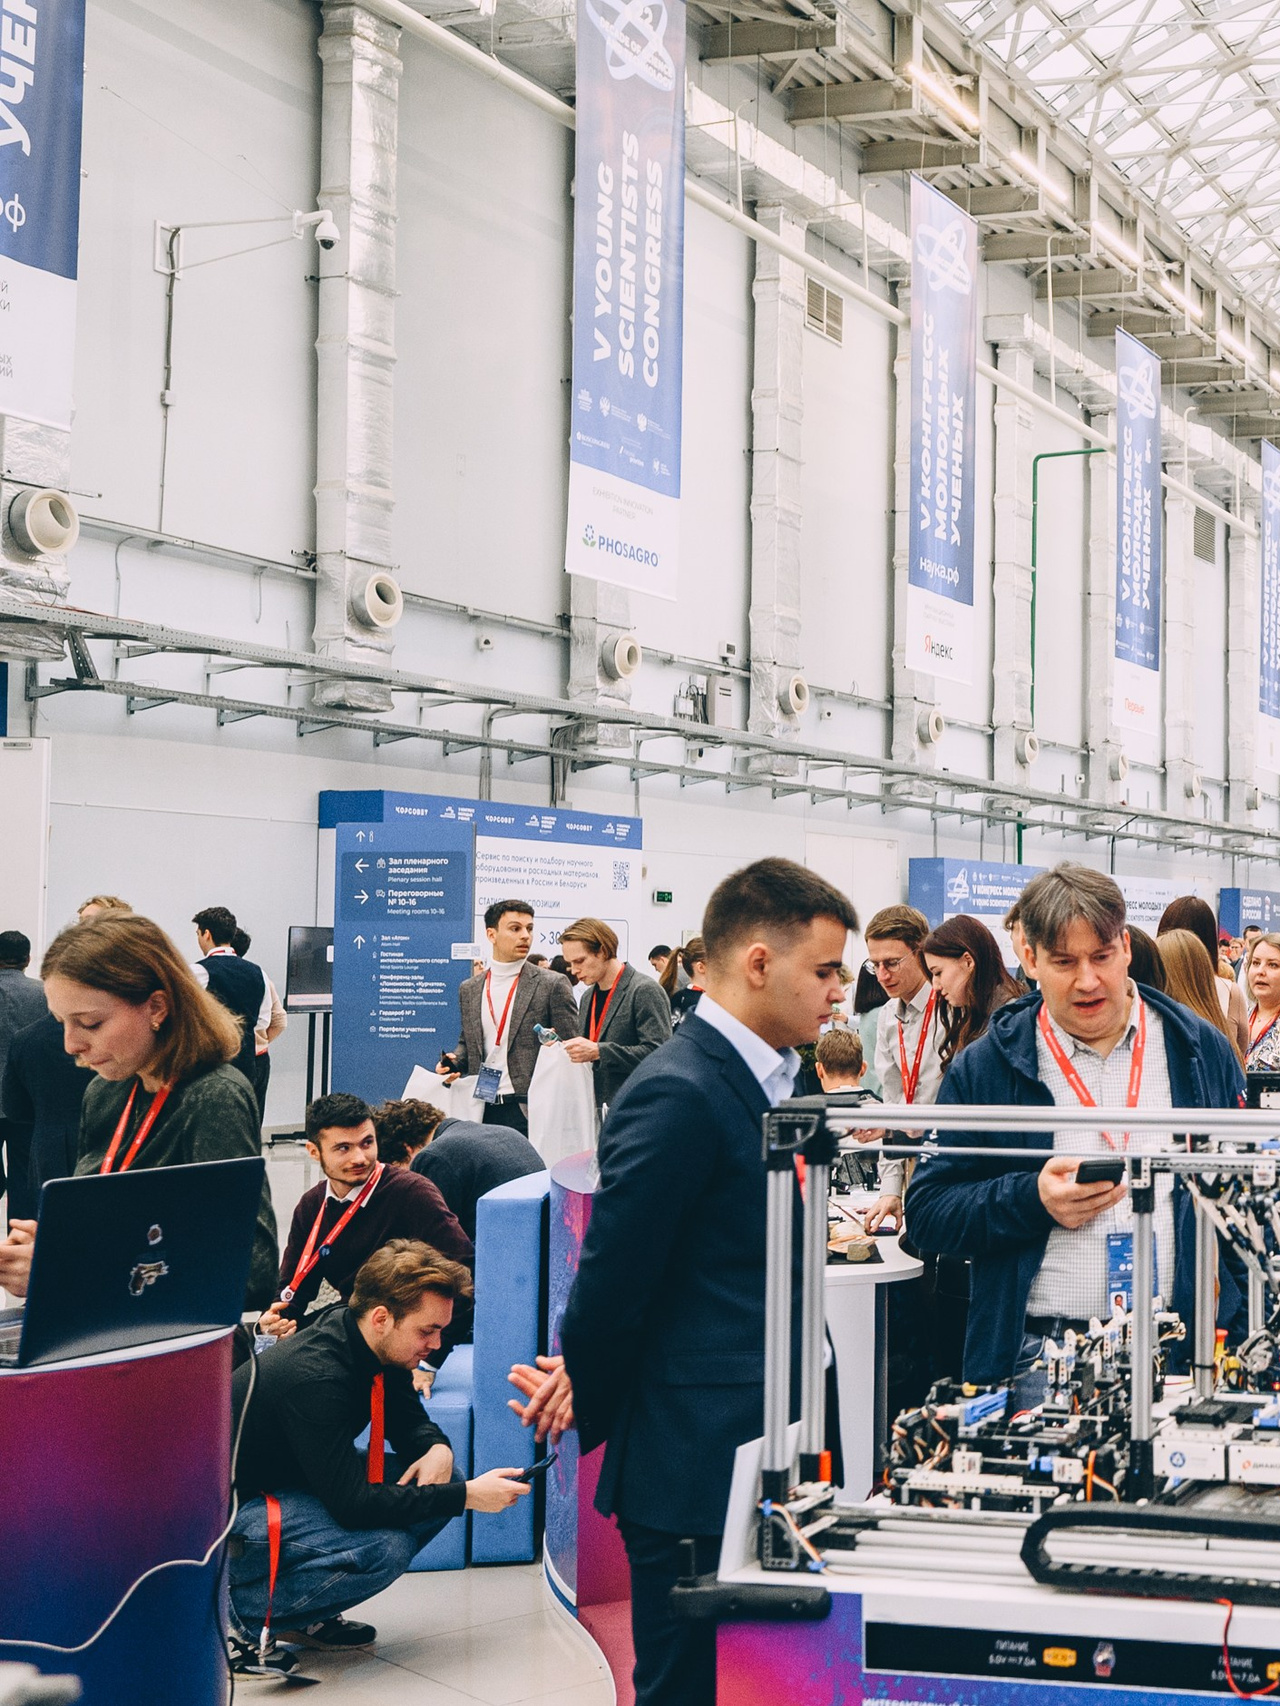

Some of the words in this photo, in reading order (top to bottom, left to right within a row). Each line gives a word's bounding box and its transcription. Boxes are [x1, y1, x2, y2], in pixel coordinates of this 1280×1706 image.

[595, 161, 614, 318] YOUNG
[618, 130, 640, 379] SCIENTISTS
[643, 157, 663, 388] CONGRESS
[593, 327, 611, 362] V
[921, 311, 934, 500] КОНГРЕСС
[934, 344, 950, 541] МОЛОДЫХ
[951, 392, 964, 547] УЧЕНЫХ
[1122, 425, 1132, 576] КОНГРЕСС
[598, 535, 659, 567] PHOSAGRO
[1132, 450, 1143, 607] МОЛОДЫХ
[1142, 487, 1151, 611] УЧЕНЫХ
[920, 556, 960, 587] наука.рф
[1263, 519, 1271, 644] КОНГРЕСС
[1269, 539, 1277, 669] МОЛОДЫХ
[925, 635, 953, 660] Яндекс
[388, 857, 402, 865] Зал
[403, 858, 449, 866] пленарного
[388, 890, 444, 898] Переговорные
[476, 851, 500, 861] Сервис
[511, 855, 532, 863] поиску
[540, 856, 565, 866] подбору
[567, 859, 594, 868] научного
[476, 862, 522, 873] оборудования
[528, 868, 562, 876] расходных
[531, 878, 553, 886] России
[560, 880, 587, 889] Беларуси
[387, 908, 410, 916] Meeting
[388, 898, 397, 906] №
